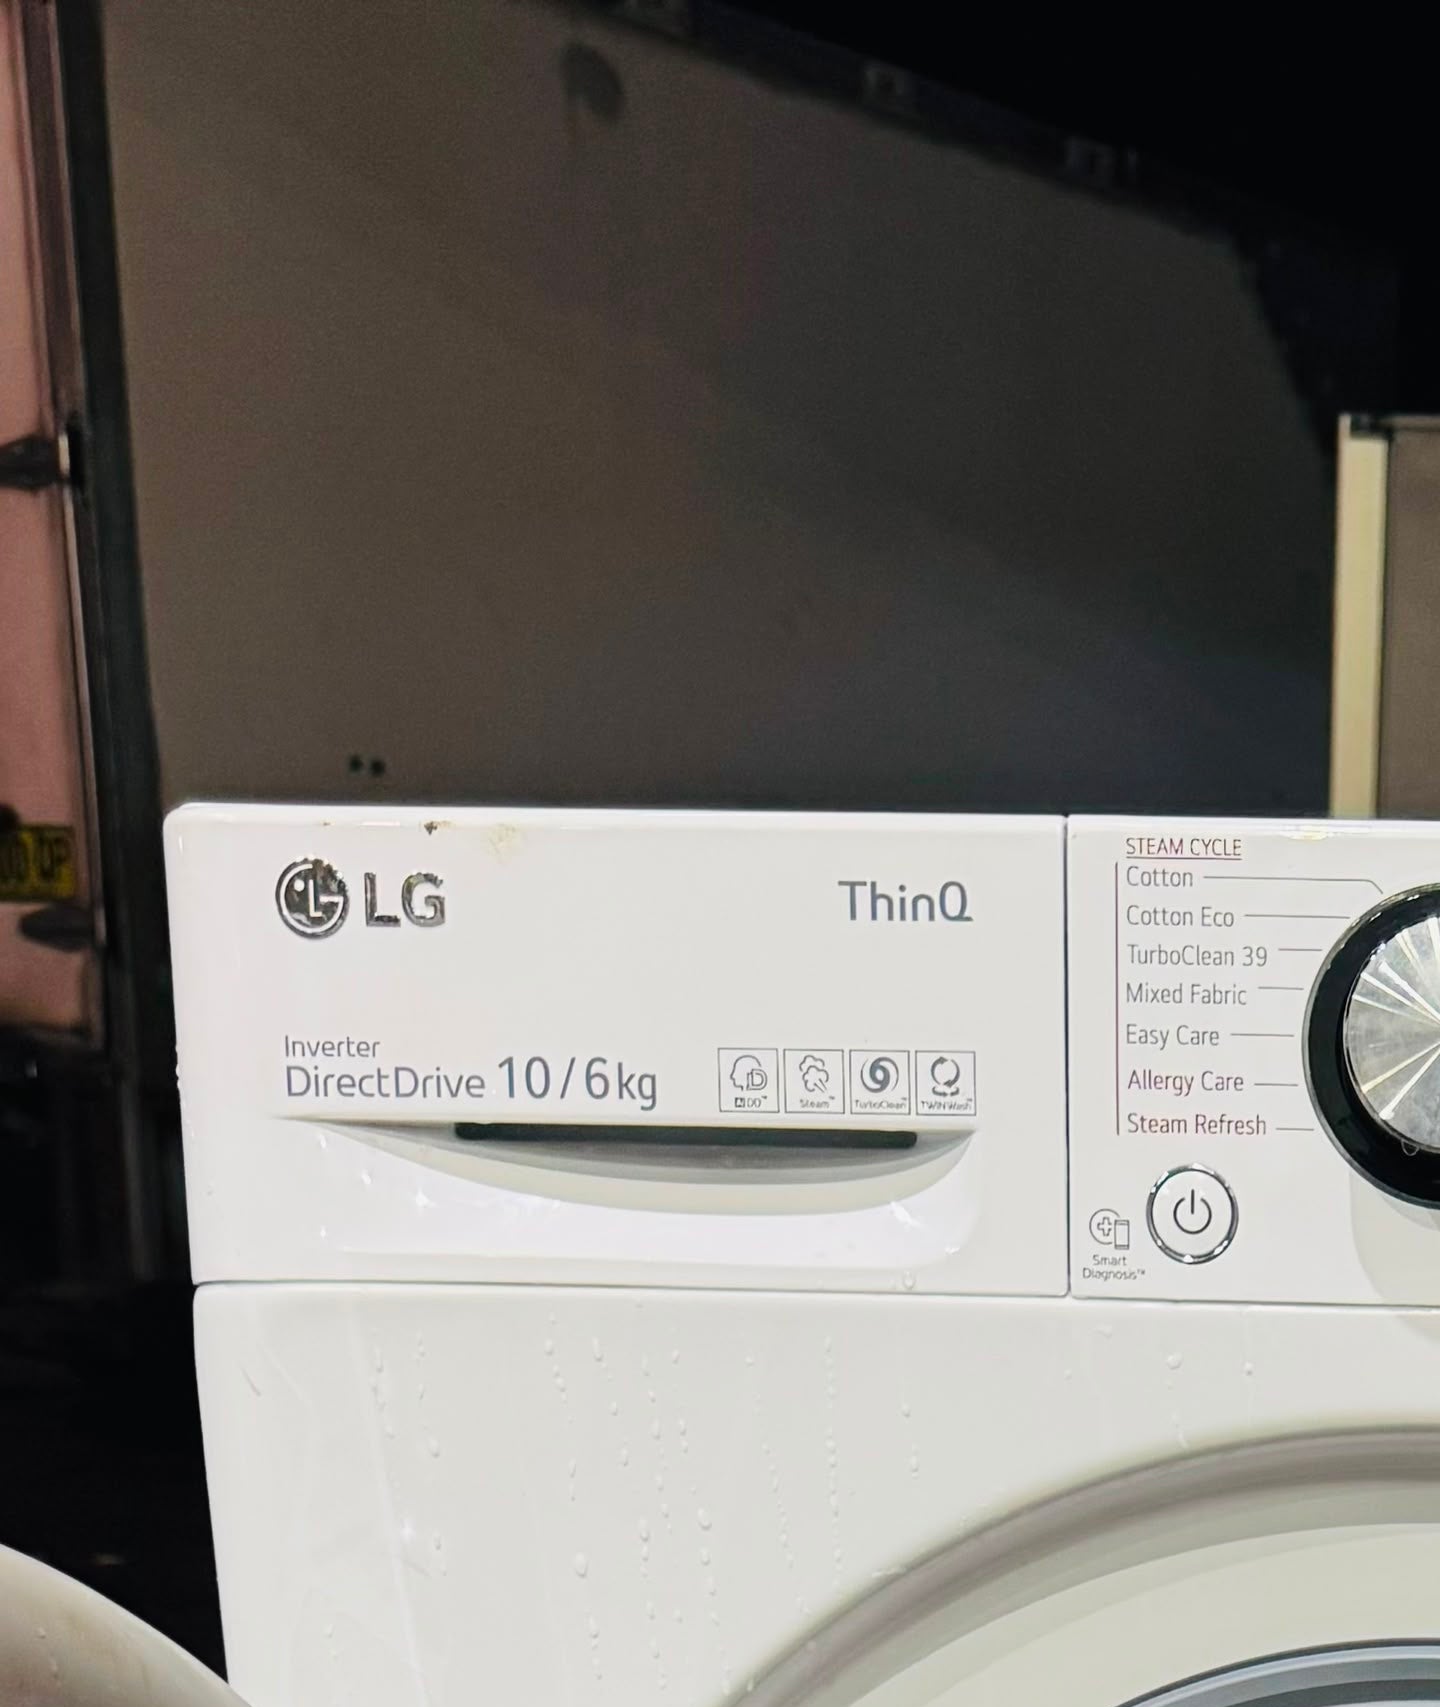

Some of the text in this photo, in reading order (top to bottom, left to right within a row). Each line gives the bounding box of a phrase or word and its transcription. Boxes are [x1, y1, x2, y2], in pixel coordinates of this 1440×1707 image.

[1126, 838, 1242, 856] STEAM CYCLE
[1126, 865, 1193, 887] Cotton
[364, 872, 446, 927] LG
[838, 879, 974, 924] ThinQ
[1126, 905, 1234, 927] Cotton Eco
[1127, 944, 1267, 967] TurboClean 39
[1126, 982, 1247, 1005] Mixed Fabric
[285, 1035, 380, 1058] Inverter
[1126, 1023, 1220, 1050] Easy Care
[1128, 1069, 1244, 1096] Allergy Care
[1127, 1112, 1266, 1135] Steam Refresh
[1092, 1254, 1127, 1267] Smart
